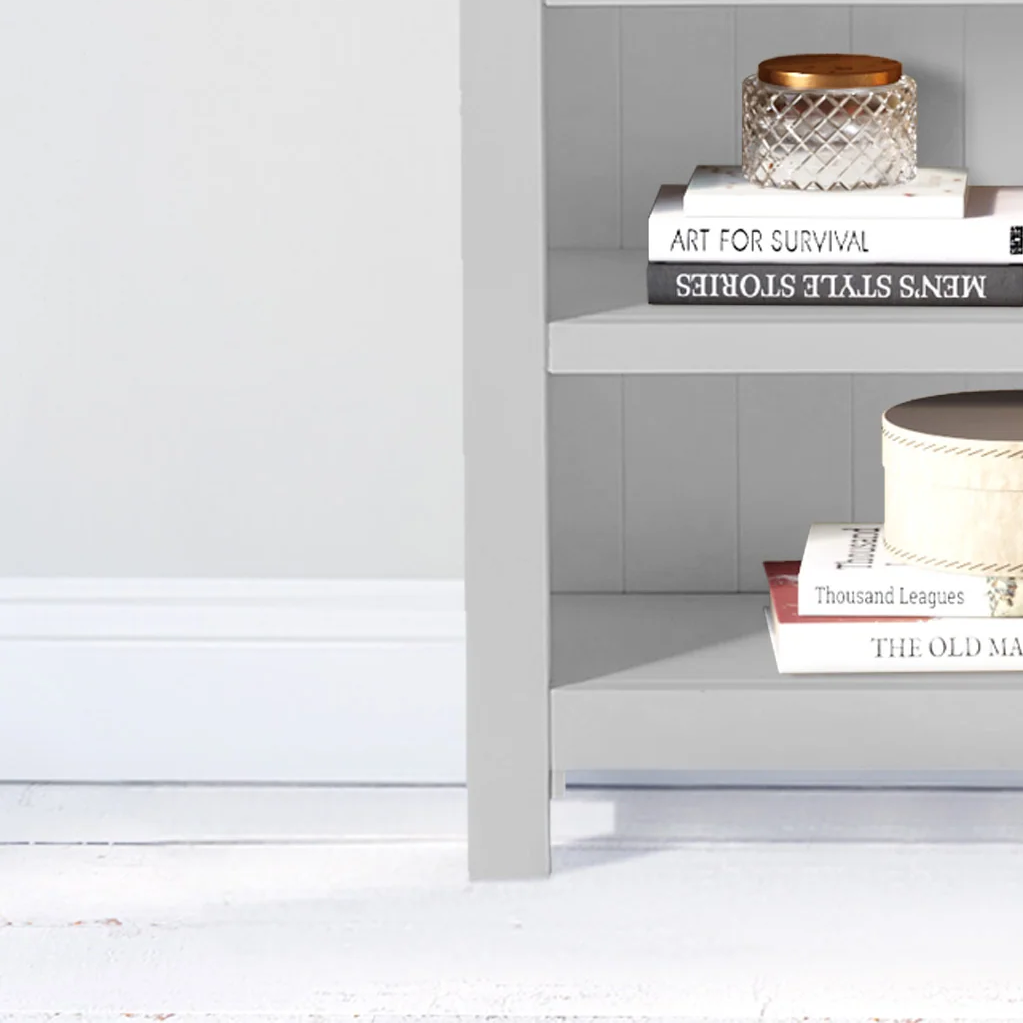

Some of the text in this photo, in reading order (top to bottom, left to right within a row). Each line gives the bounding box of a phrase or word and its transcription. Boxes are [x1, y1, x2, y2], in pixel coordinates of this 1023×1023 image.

[670, 229, 869, 253] ART FOR SURVIVAL
[676, 273, 987, 299] MEN'S STYLE STORIES
[835, 527, 880, 570] Thousand
[815, 585, 965, 609] Thousand Leagues
[870, 636, 922, 658] THE
[928, 635, 982, 658] OLD
